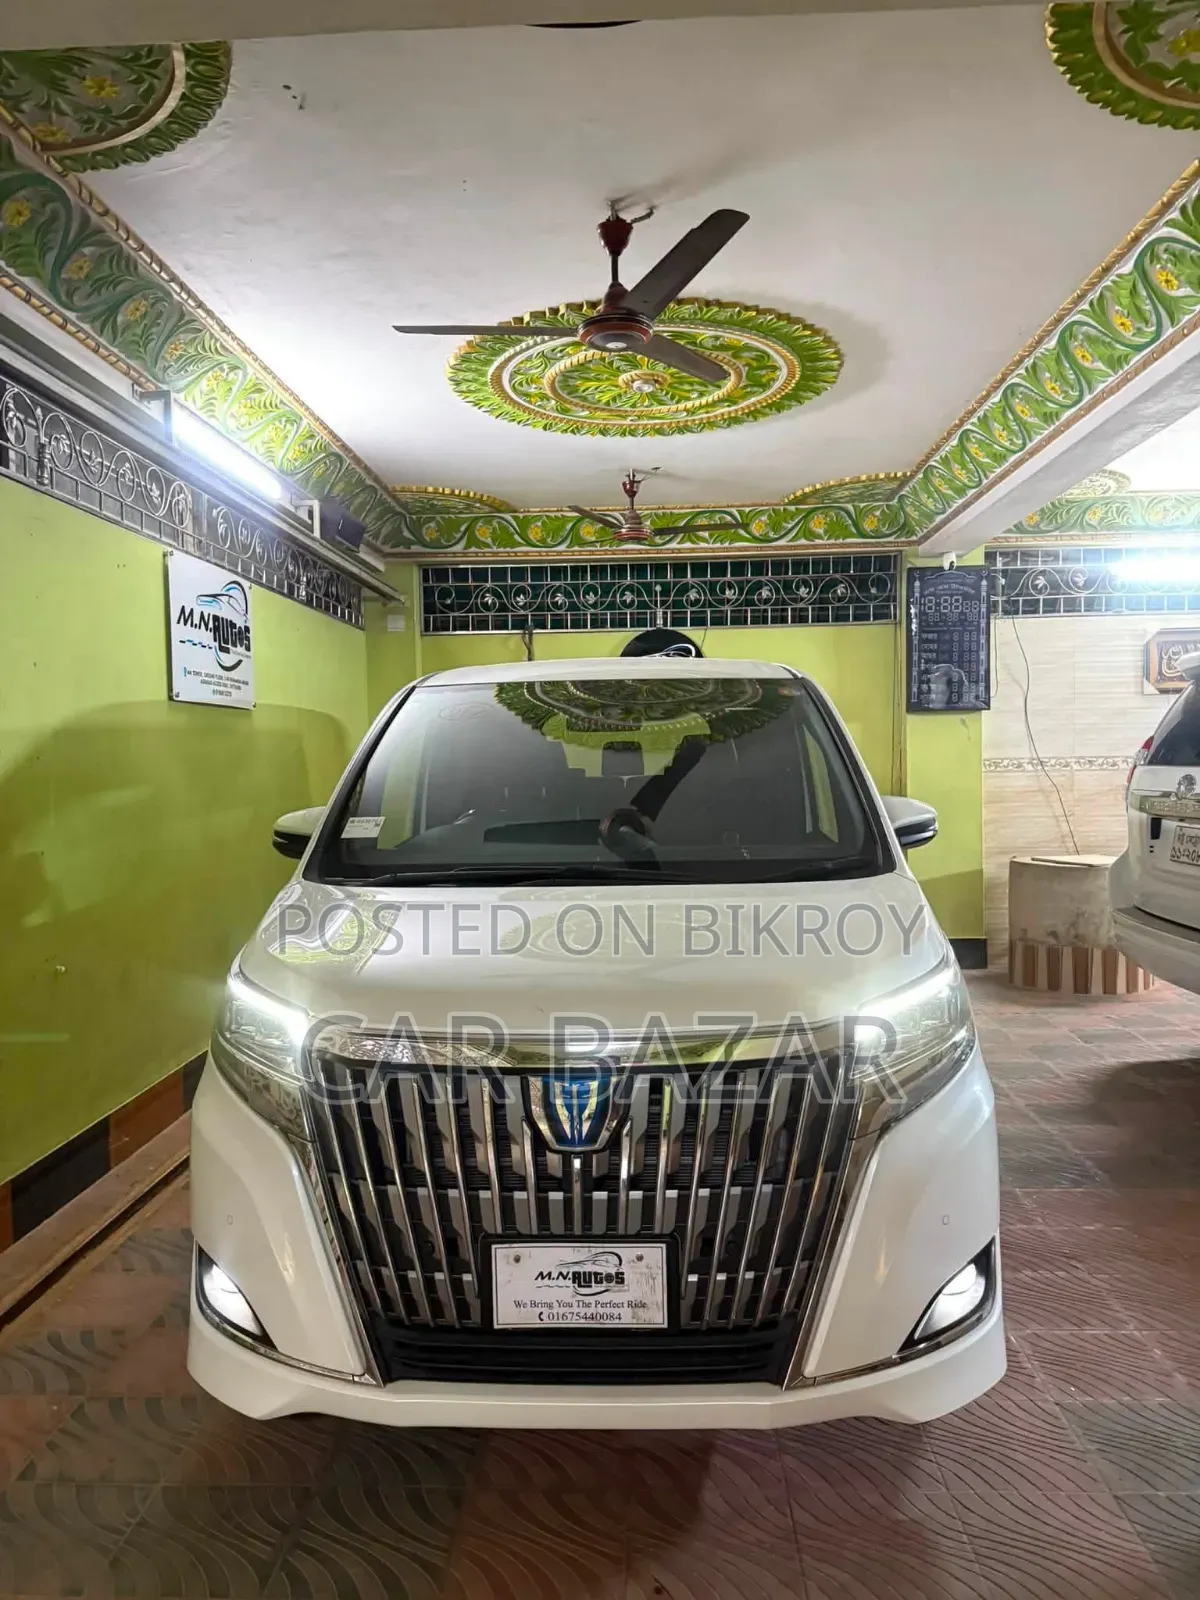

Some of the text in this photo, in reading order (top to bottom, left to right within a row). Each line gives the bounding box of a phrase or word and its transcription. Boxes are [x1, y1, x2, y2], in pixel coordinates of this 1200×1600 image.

[513, 1300, 527, 1309] We
[529, 1300, 554, 1310] Bring
[556, 1300, 573, 1309] You
[575, 1300, 592, 1309] The
[594, 1300, 625, 1309] Perfect
[547, 1311, 623, 1322] 01675440084
